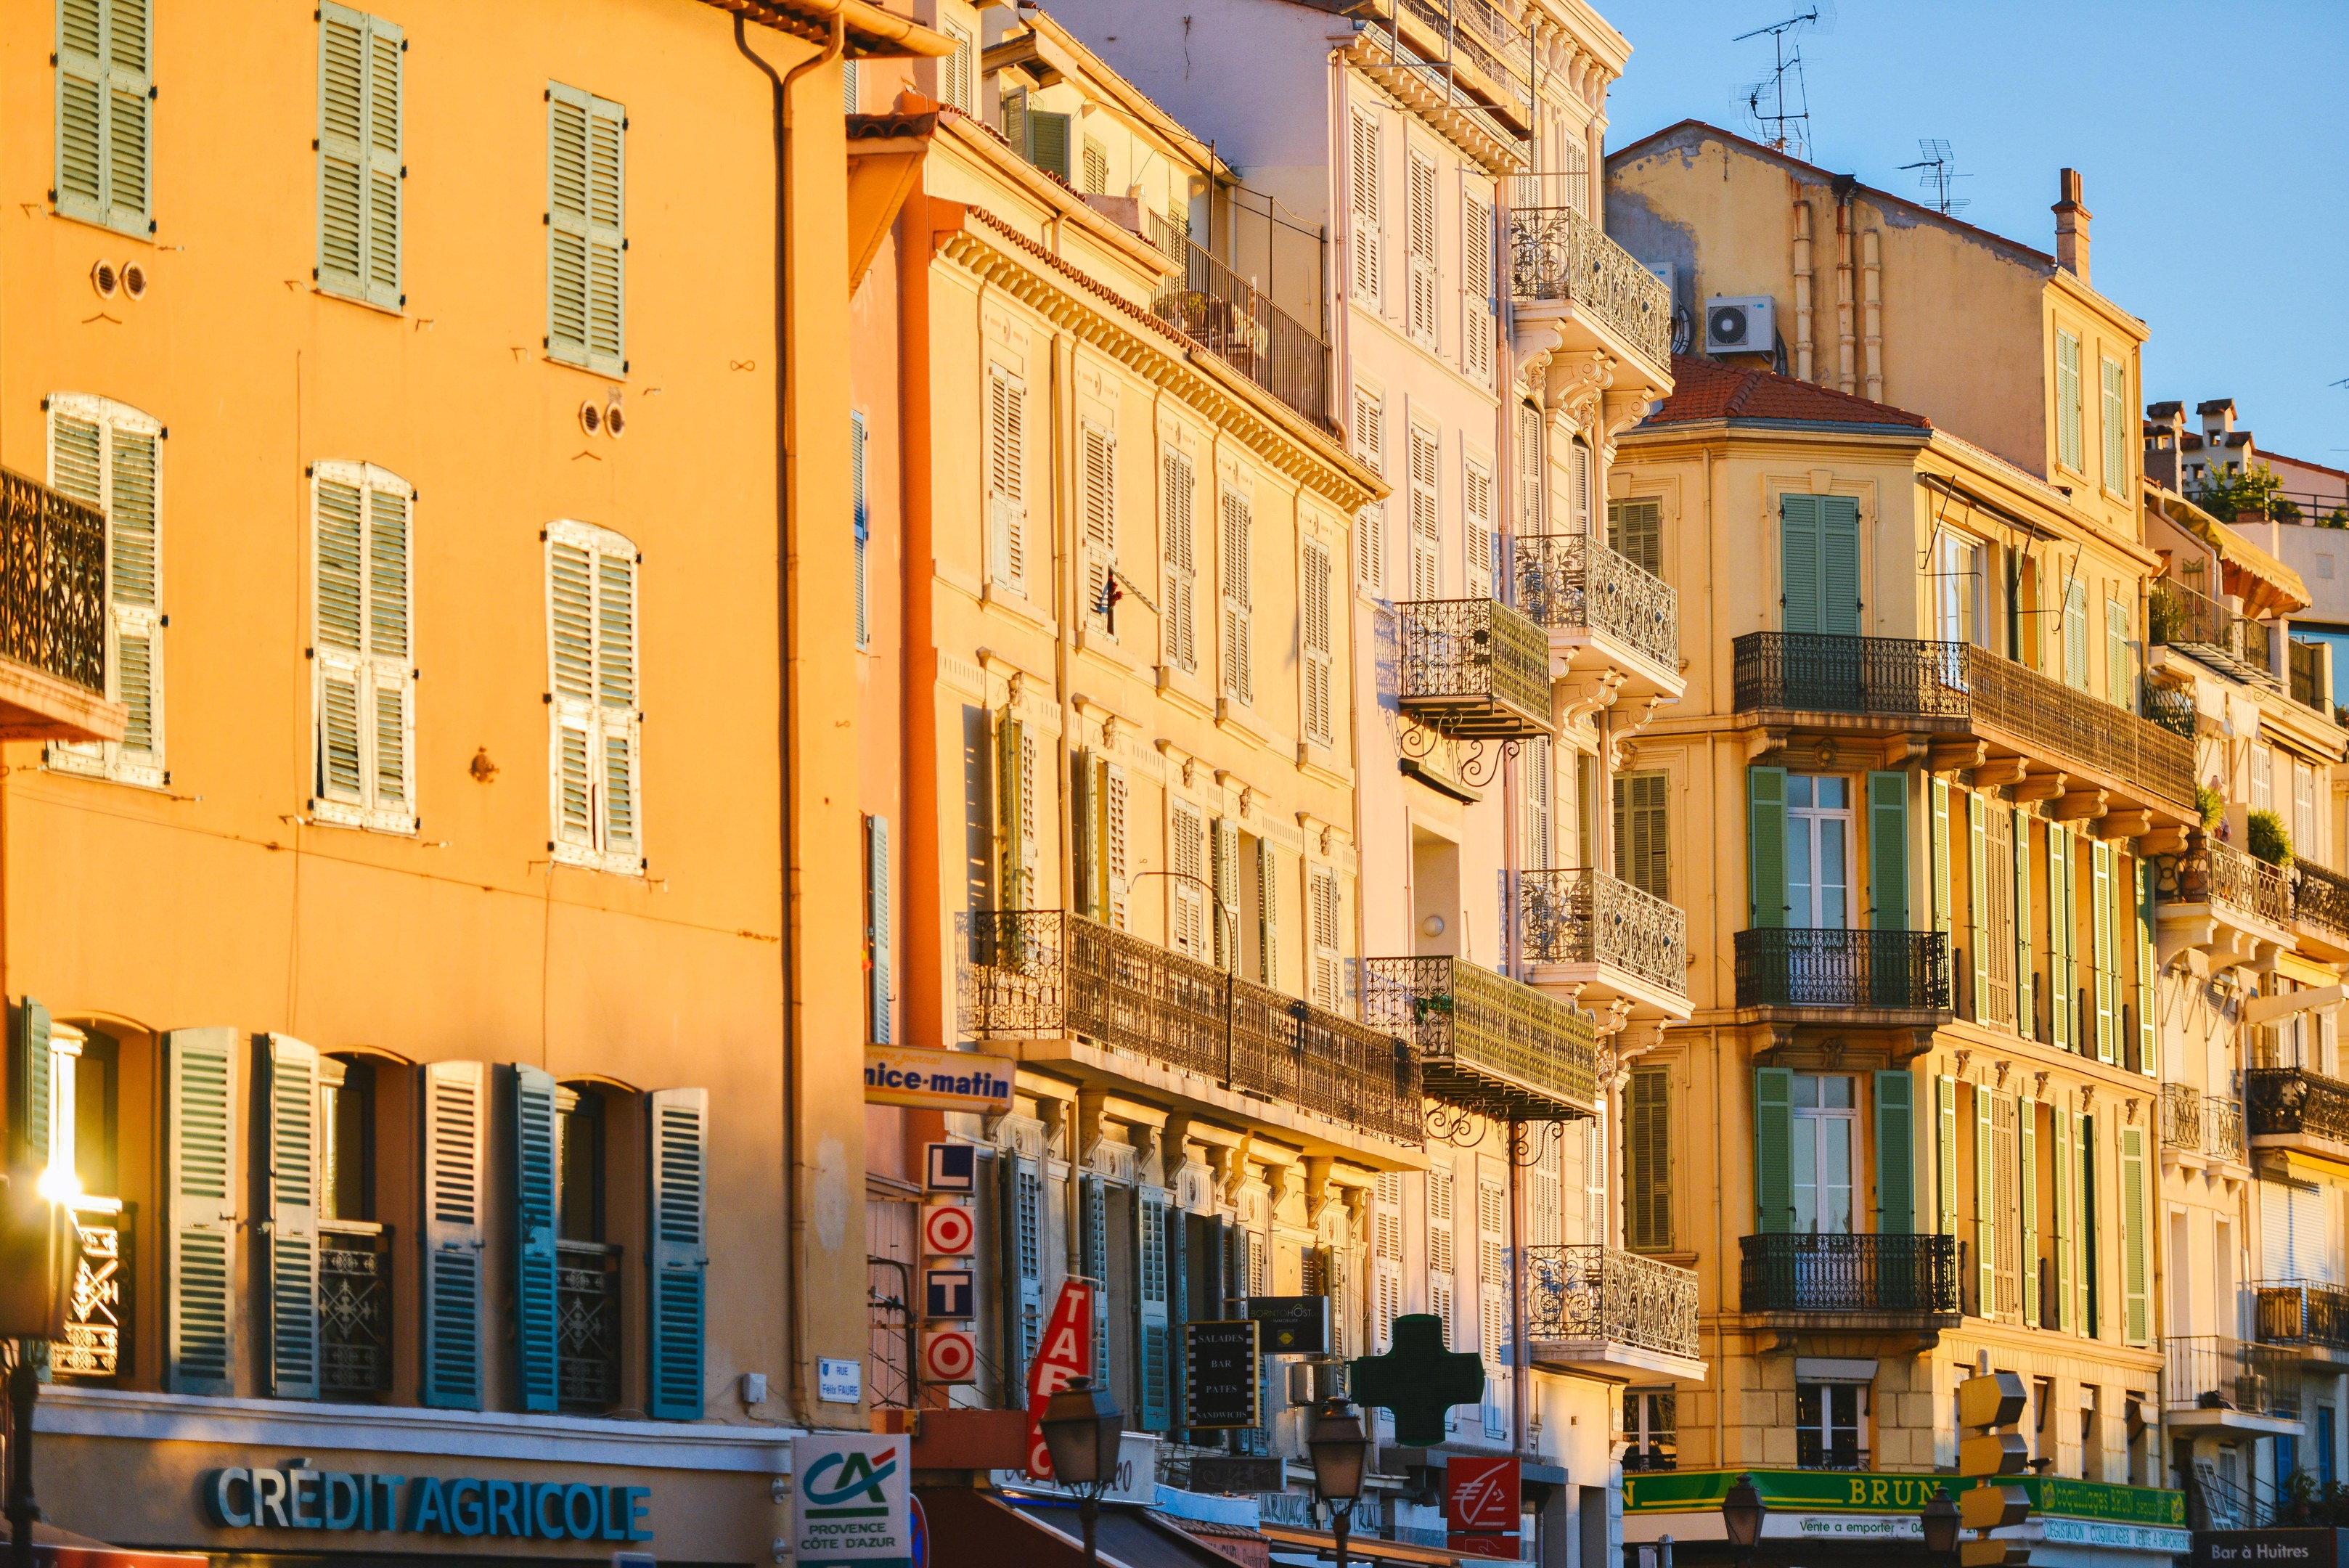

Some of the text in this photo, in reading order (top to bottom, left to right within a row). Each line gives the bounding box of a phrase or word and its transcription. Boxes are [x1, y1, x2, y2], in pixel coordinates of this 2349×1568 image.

[1198, 1334, 1244, 1343] SALADES
[1211, 1360, 1232, 1368] BAR
[836, 1365, 849, 1376] RUE
[838, 1385, 858, 1396] FAURE
[1206, 1384, 1238, 1394] PATES
[217, 1457, 654, 1541] CRÉDIT AGRICOLE
[809, 1523, 886, 1535] PROVENCE
[1799, 1522, 1830, 1532] Vente
[1846, 1522, 1895, 1535] emporter
[801, 1537, 896, 1550] CÔTE D'AZUR
[2211, 1543, 2309, 1559] Bar à Huitres
